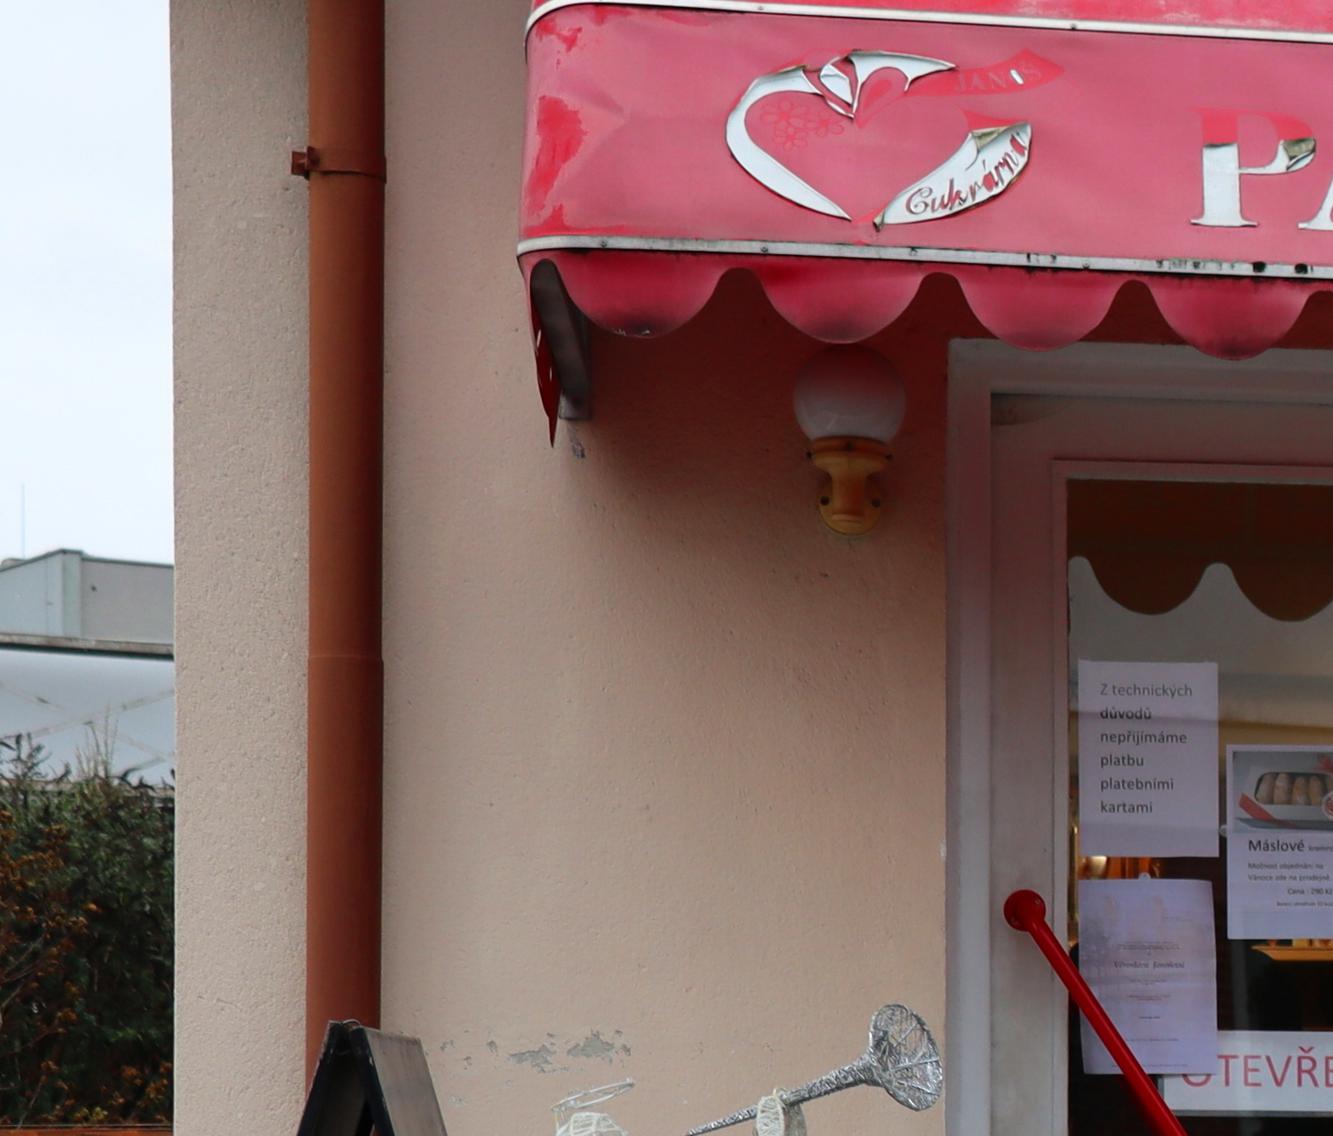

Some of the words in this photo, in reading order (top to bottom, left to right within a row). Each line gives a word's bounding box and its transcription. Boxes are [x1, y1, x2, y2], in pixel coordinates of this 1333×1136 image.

[1100, 683, 1108, 696] Z
[1112, 683, 1193, 699] technických
[1100, 706, 1152, 720] důvodů
[1100, 730, 1188, 746] nepřijímáme
[1100, 754, 1144, 769] platbu
[1100, 777, 1174, 793] platebními
[1100, 801, 1153, 814] kartami
[1248, 839, 1305, 853] Máslové
